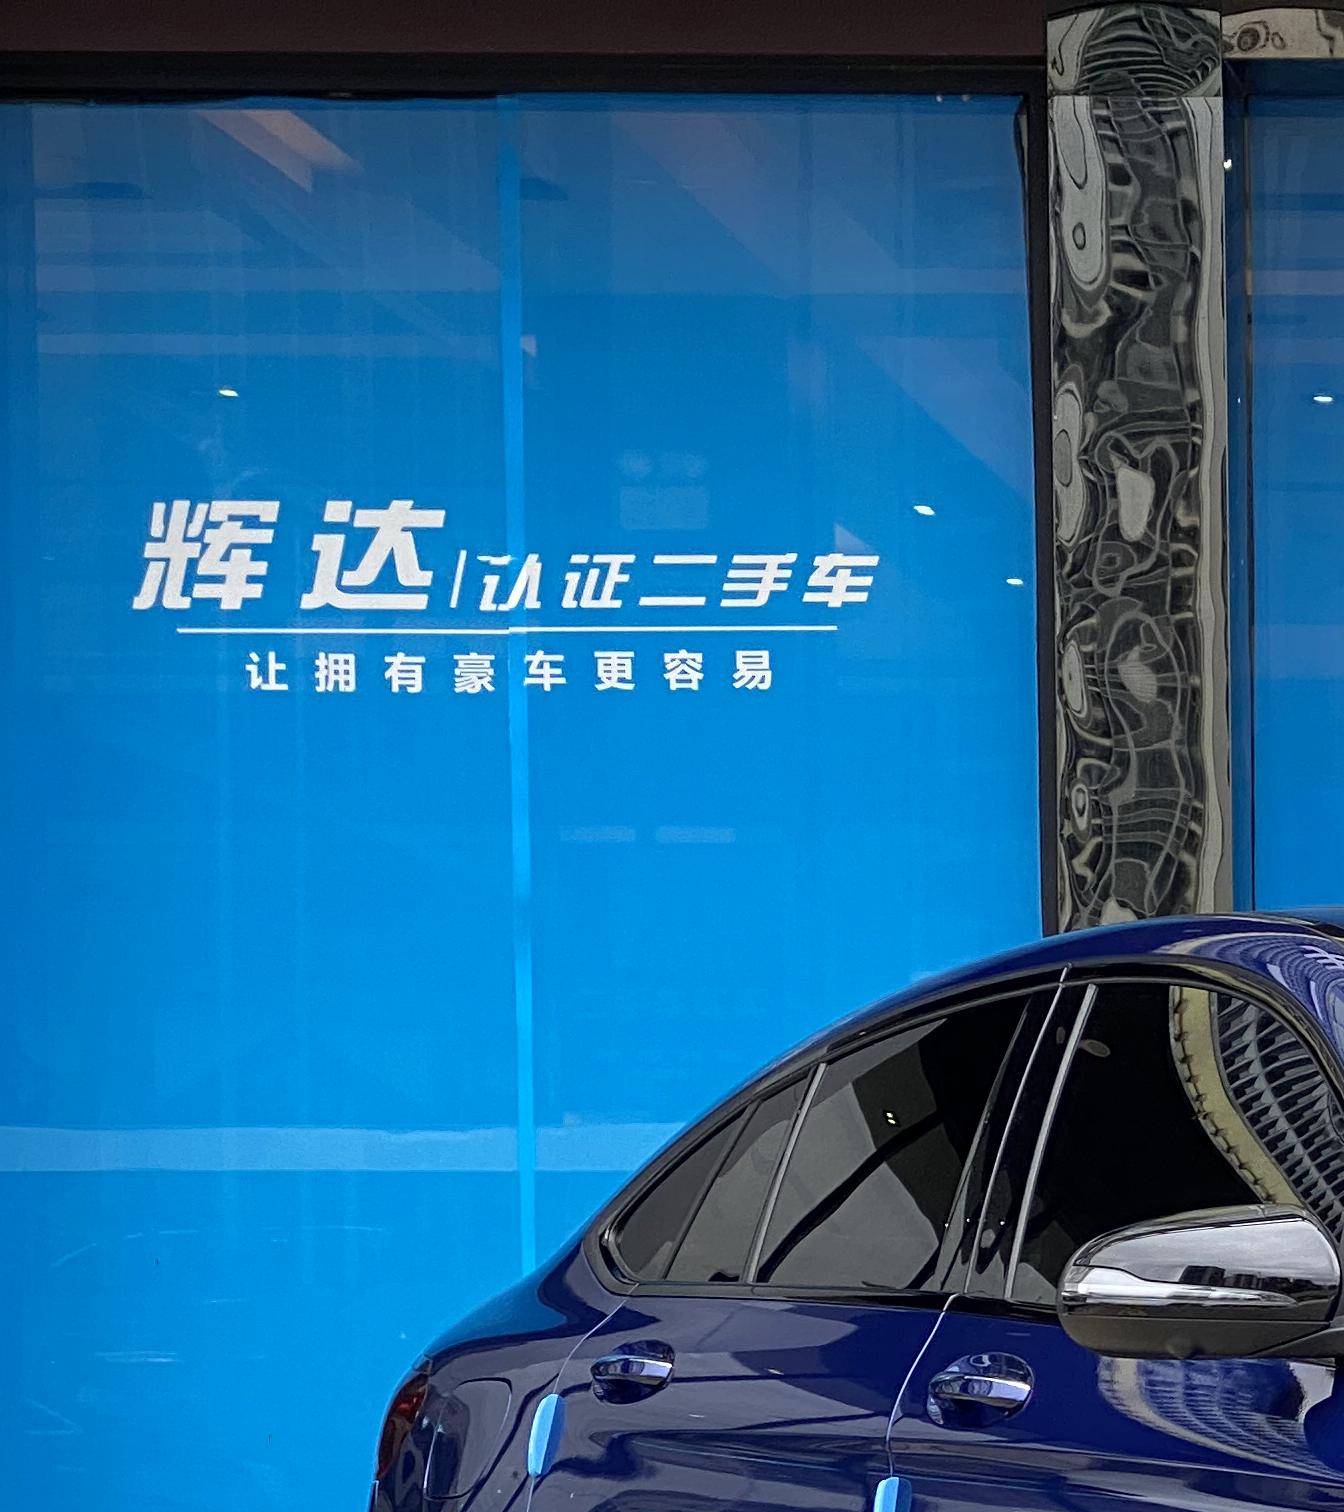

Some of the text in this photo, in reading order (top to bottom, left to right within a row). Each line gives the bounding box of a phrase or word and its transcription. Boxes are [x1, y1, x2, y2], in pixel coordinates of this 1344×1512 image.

[132, 499, 880, 612] 辉达 认证二手车
[245, 649, 773, 694] 让拥有豪车更容易
